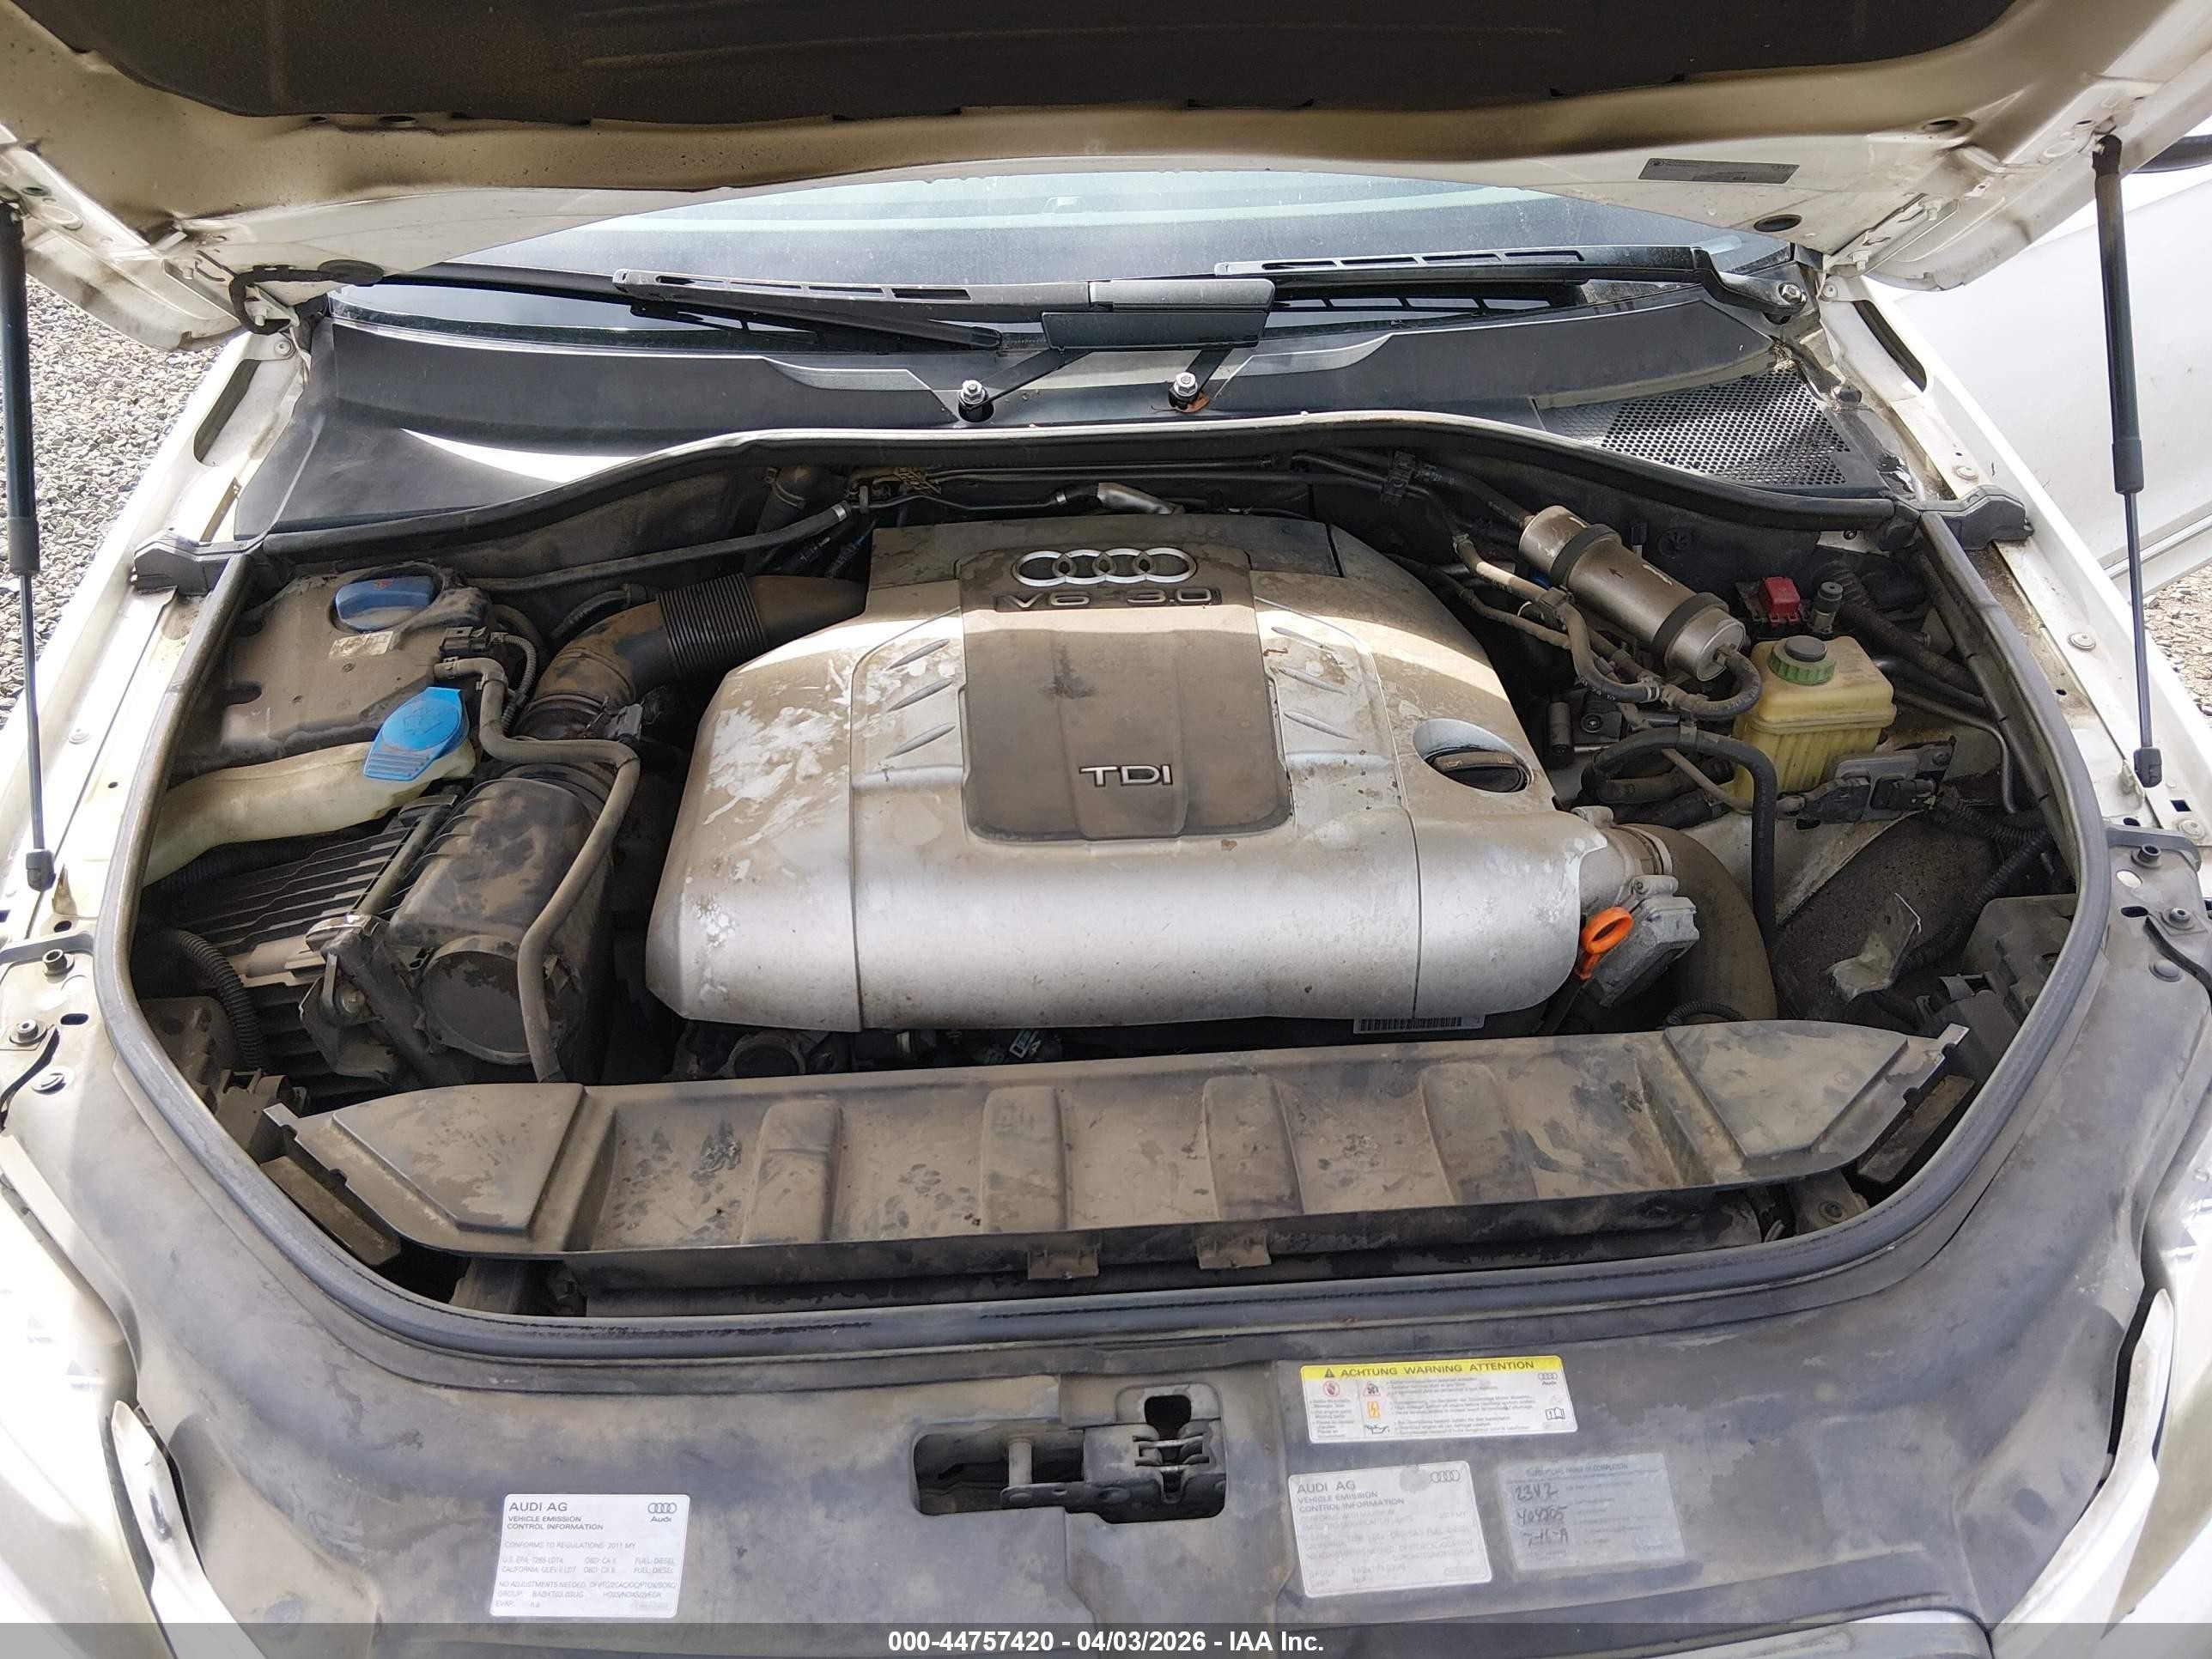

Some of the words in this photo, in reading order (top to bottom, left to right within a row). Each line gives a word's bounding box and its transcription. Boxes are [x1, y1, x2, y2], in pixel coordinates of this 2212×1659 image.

[1006, 591, 1090, 609] V6
[1127, 588, 1212, 605] 3.0
[1081, 765, 1173, 787] TDI
[1340, 1368, 1398, 1377] ACHTUNG
[1404, 1364, 1462, 1374] WARNING
[1469, 1360, 1534, 1372] ATTENTION
[1297, 1483, 1328, 1494] AUDI
[1336, 1480, 1356, 1491] AG
[1298, 1495, 1334, 1504] VEHICLE
[1335, 1491, 1378, 1501] EMISSION
[509, 1502, 543, 1512] AUDI
[547, 1502, 568, 1512] AG
[1299, 1503, 1340, 1512] CONTROL
[1342, 1498, 1405, 1510] INFORMATION
